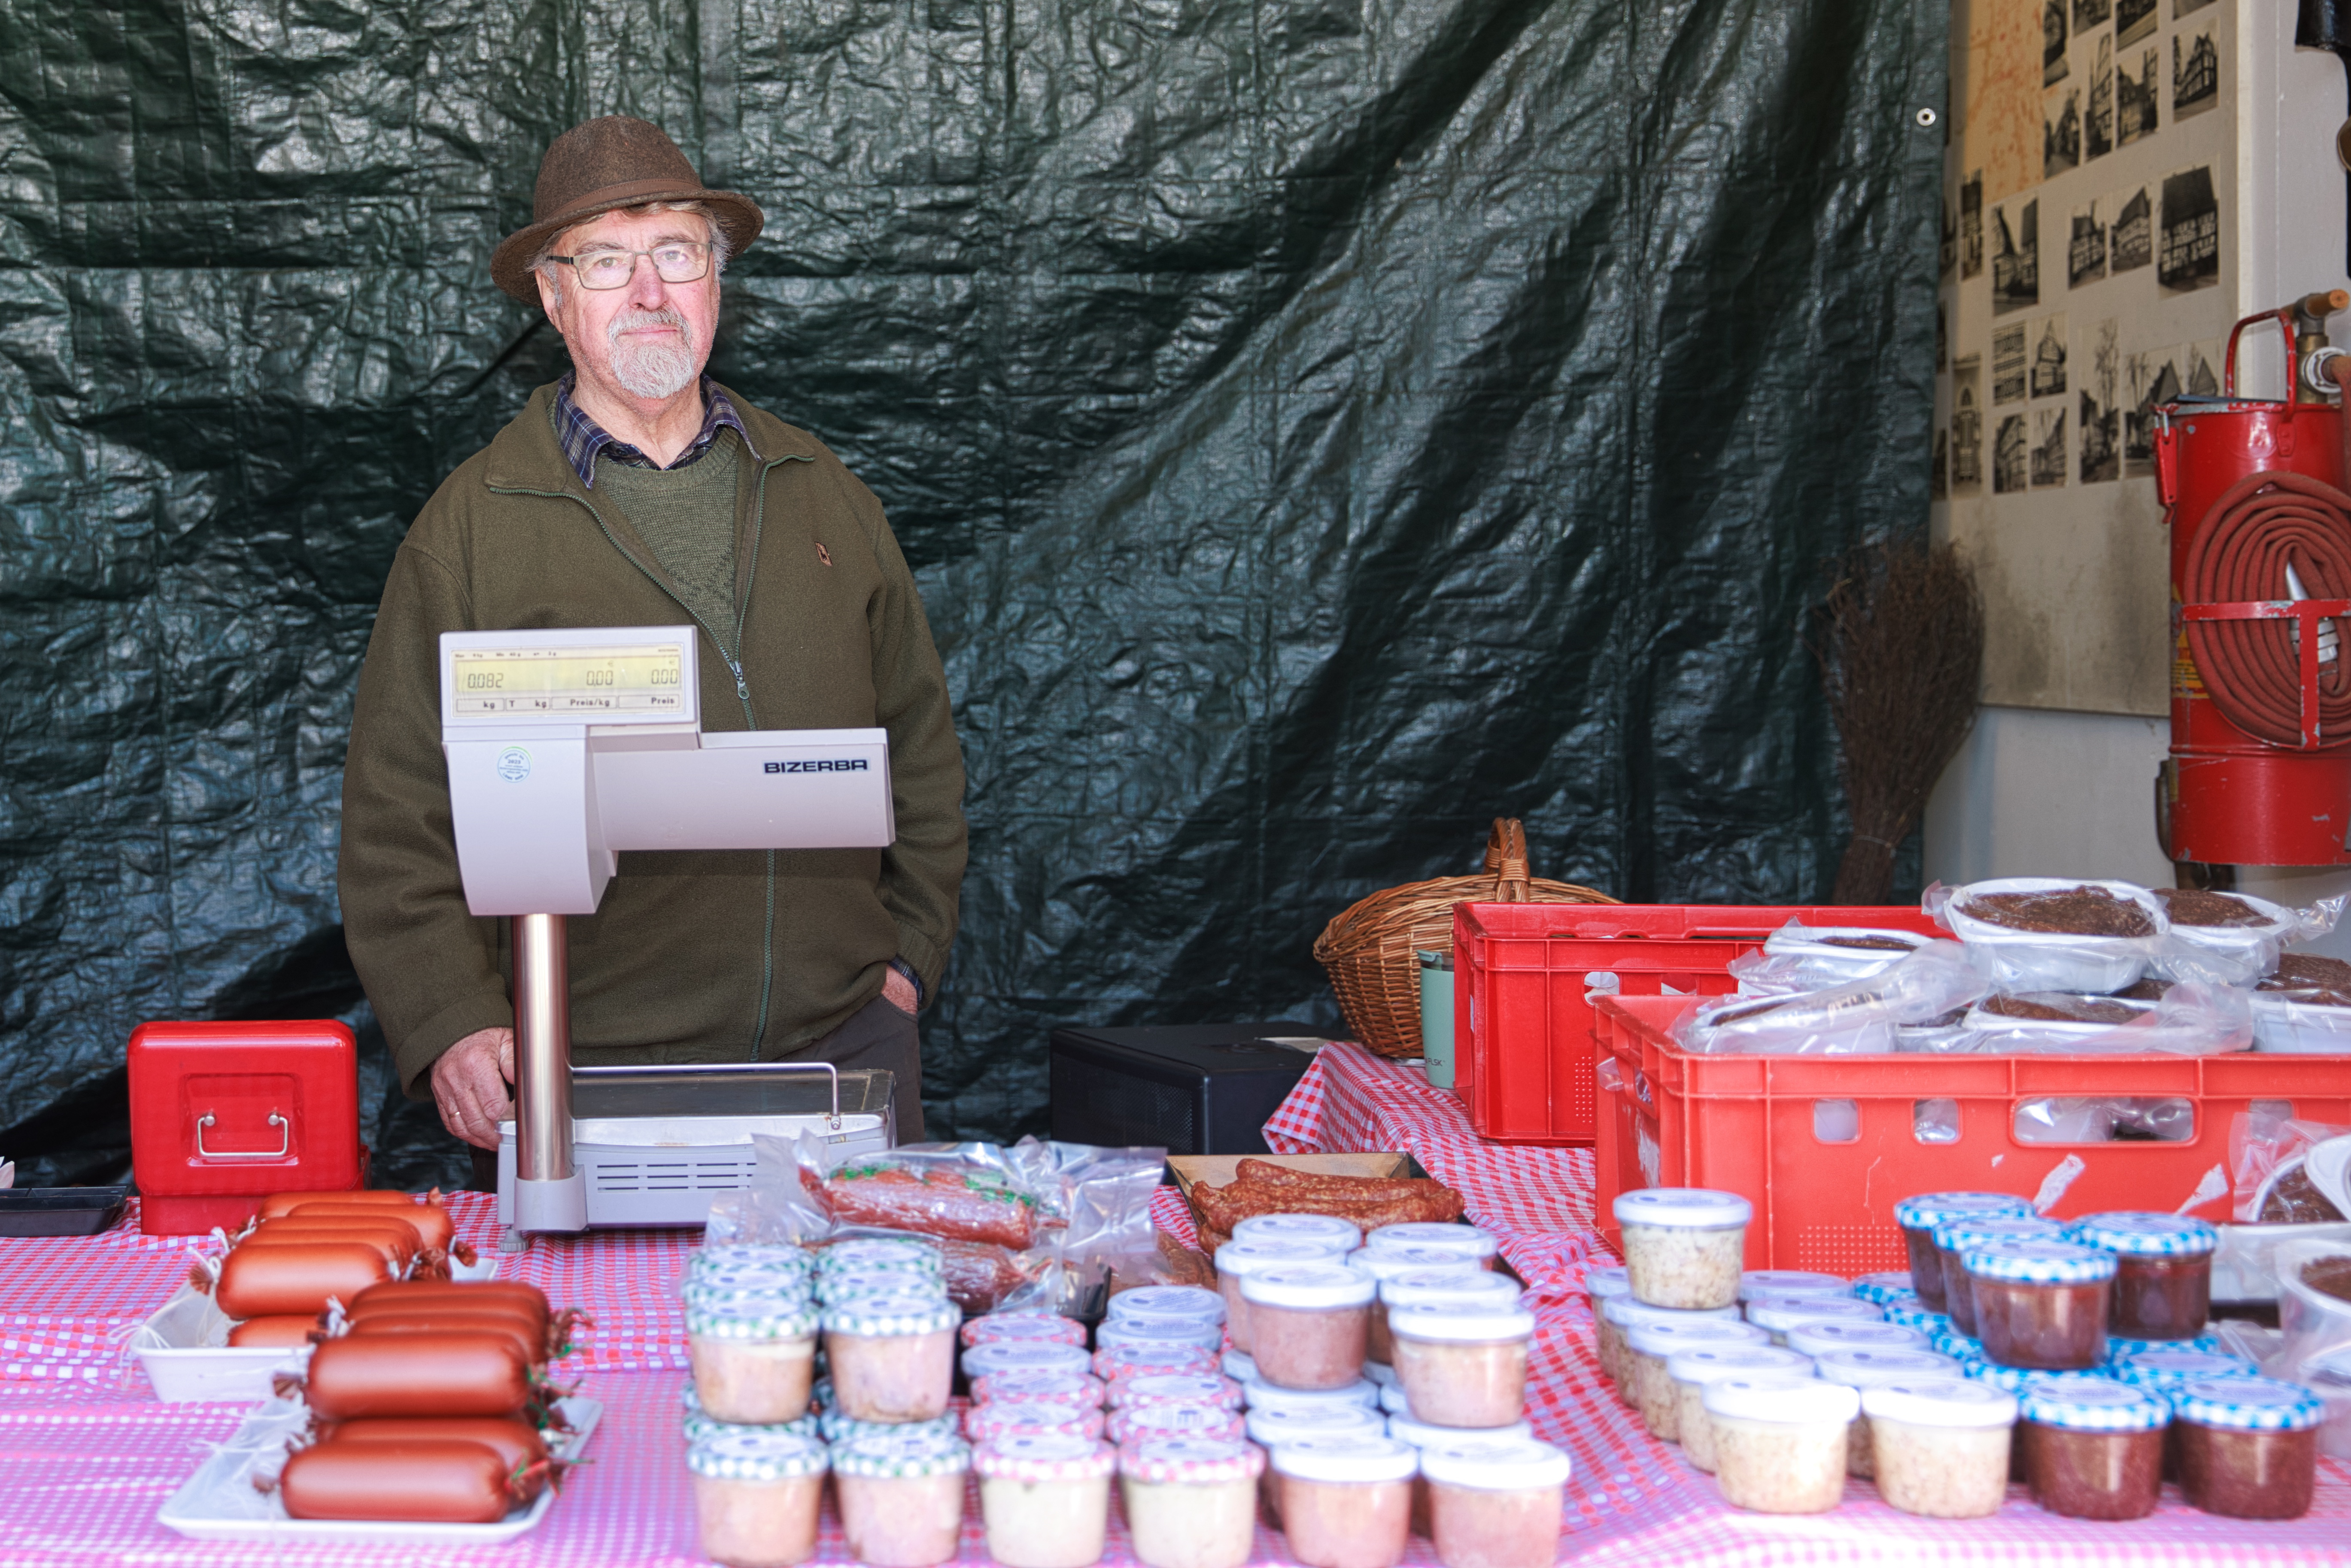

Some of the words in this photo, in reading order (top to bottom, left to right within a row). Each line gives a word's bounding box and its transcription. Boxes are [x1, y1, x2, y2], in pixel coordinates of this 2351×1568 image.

[535, 700, 547, 708] kg
[570, 698, 610, 707] Preis/kg
[651, 696, 674, 705] Preis
[764, 760, 867, 773] BIZERBA
